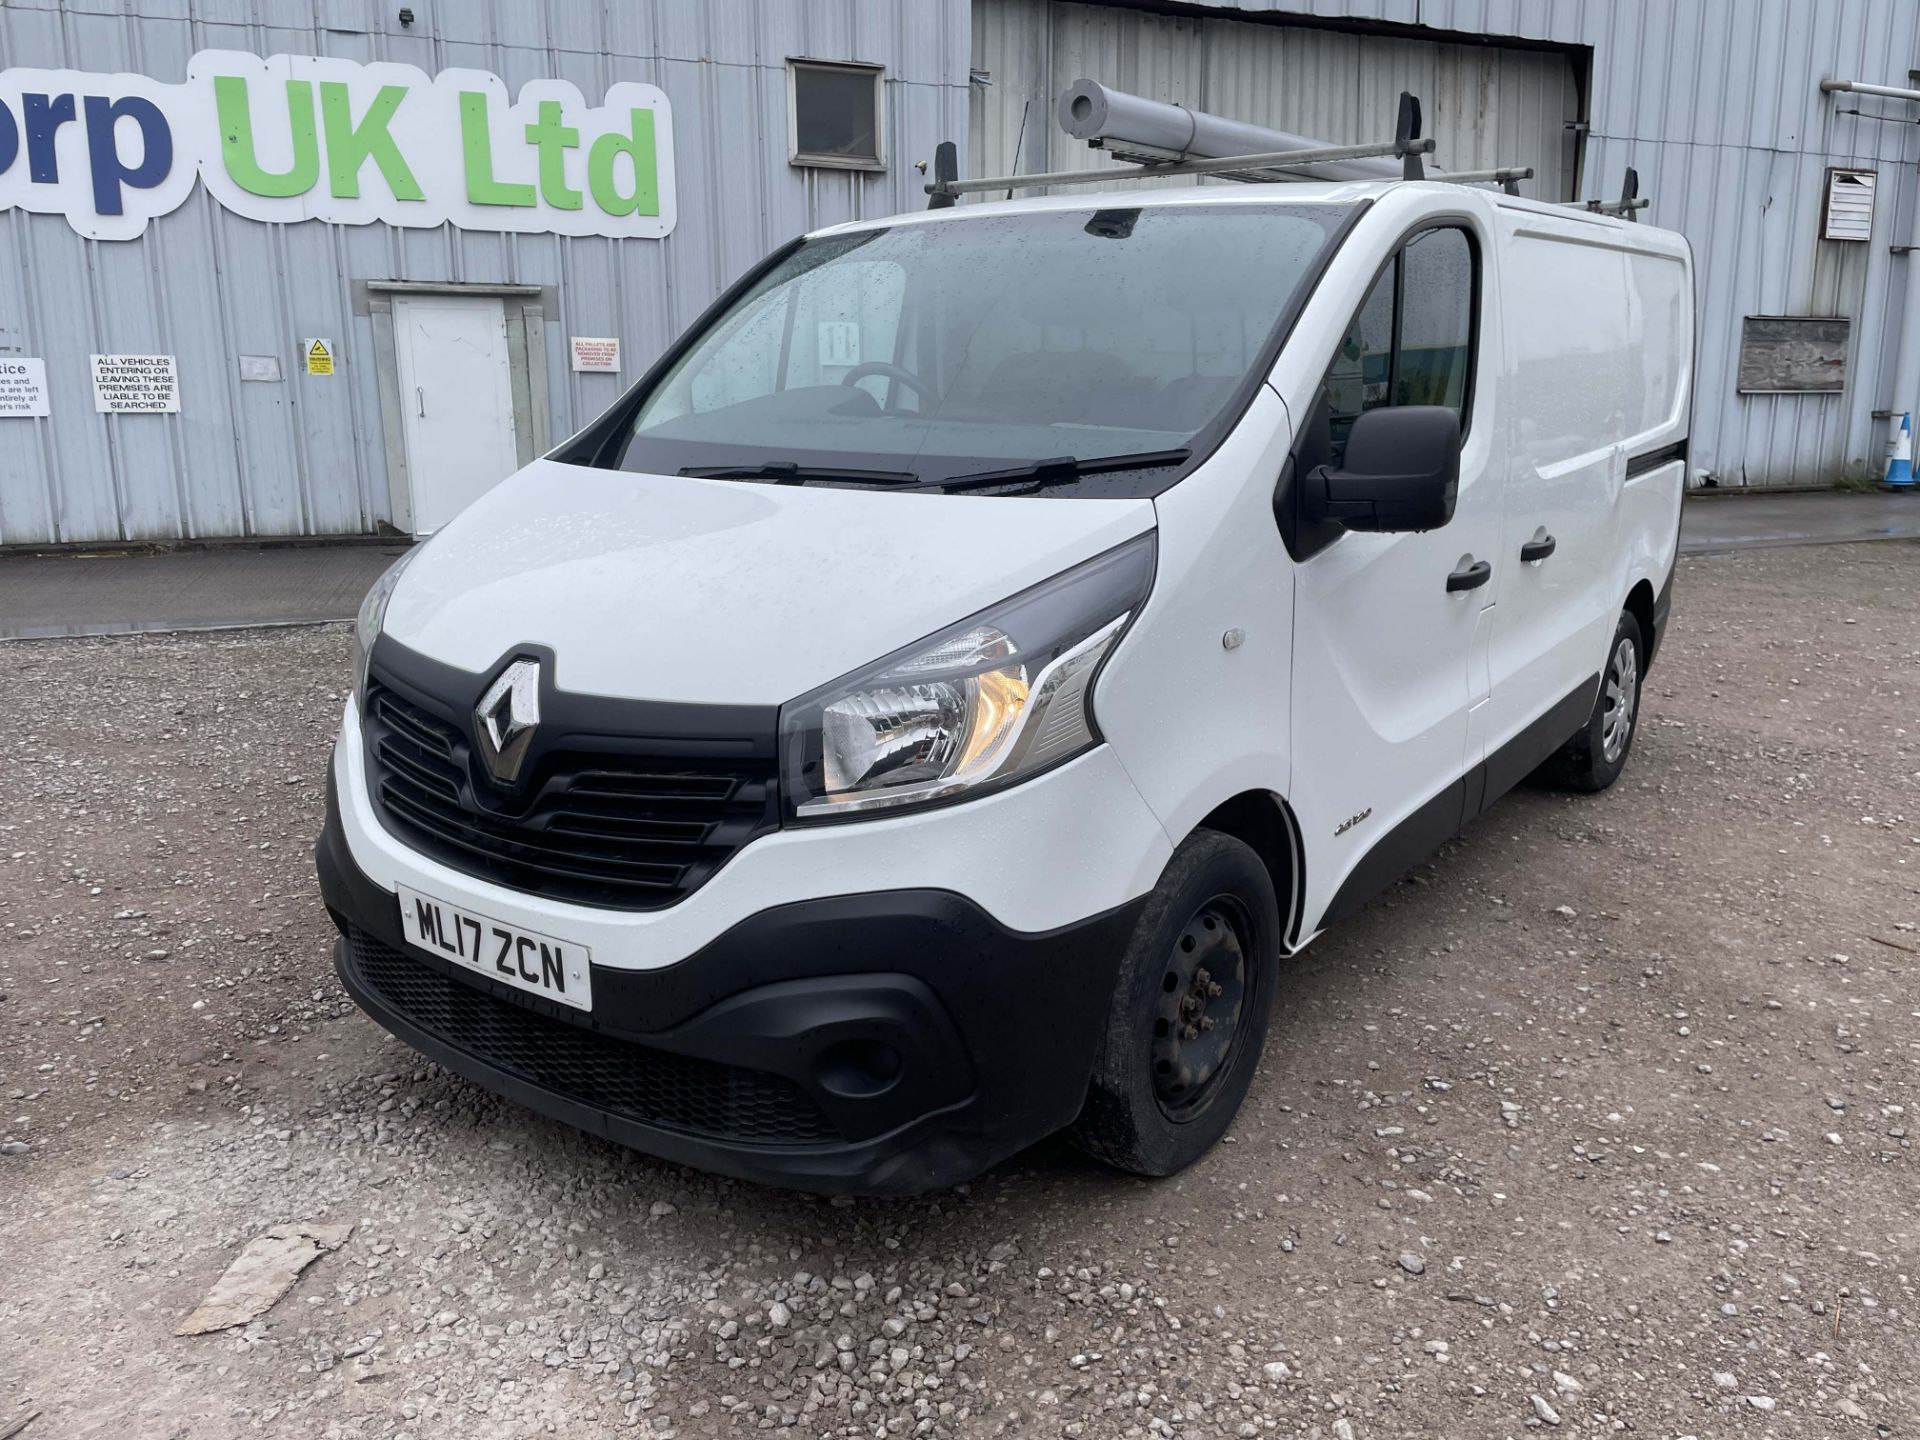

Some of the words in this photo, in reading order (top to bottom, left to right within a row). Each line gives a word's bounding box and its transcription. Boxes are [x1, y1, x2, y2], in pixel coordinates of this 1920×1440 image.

[214, 75, 426, 201] UK
[459, 91, 660, 217] Ltd
[97, 358, 118, 366] ALL
[120, 358, 170, 366] VEHICLES
[95, 375, 140, 383] LEAVING
[142, 375, 175, 383] THESE
[99, 384, 151, 392] PREMISES
[153, 384, 174, 392] ARE
[28, 394, 38, 402] at
[110, 401, 167, 409] SEARCHED
[415, 898, 482, 963] ML17
[492, 927, 566, 994] ZCN
